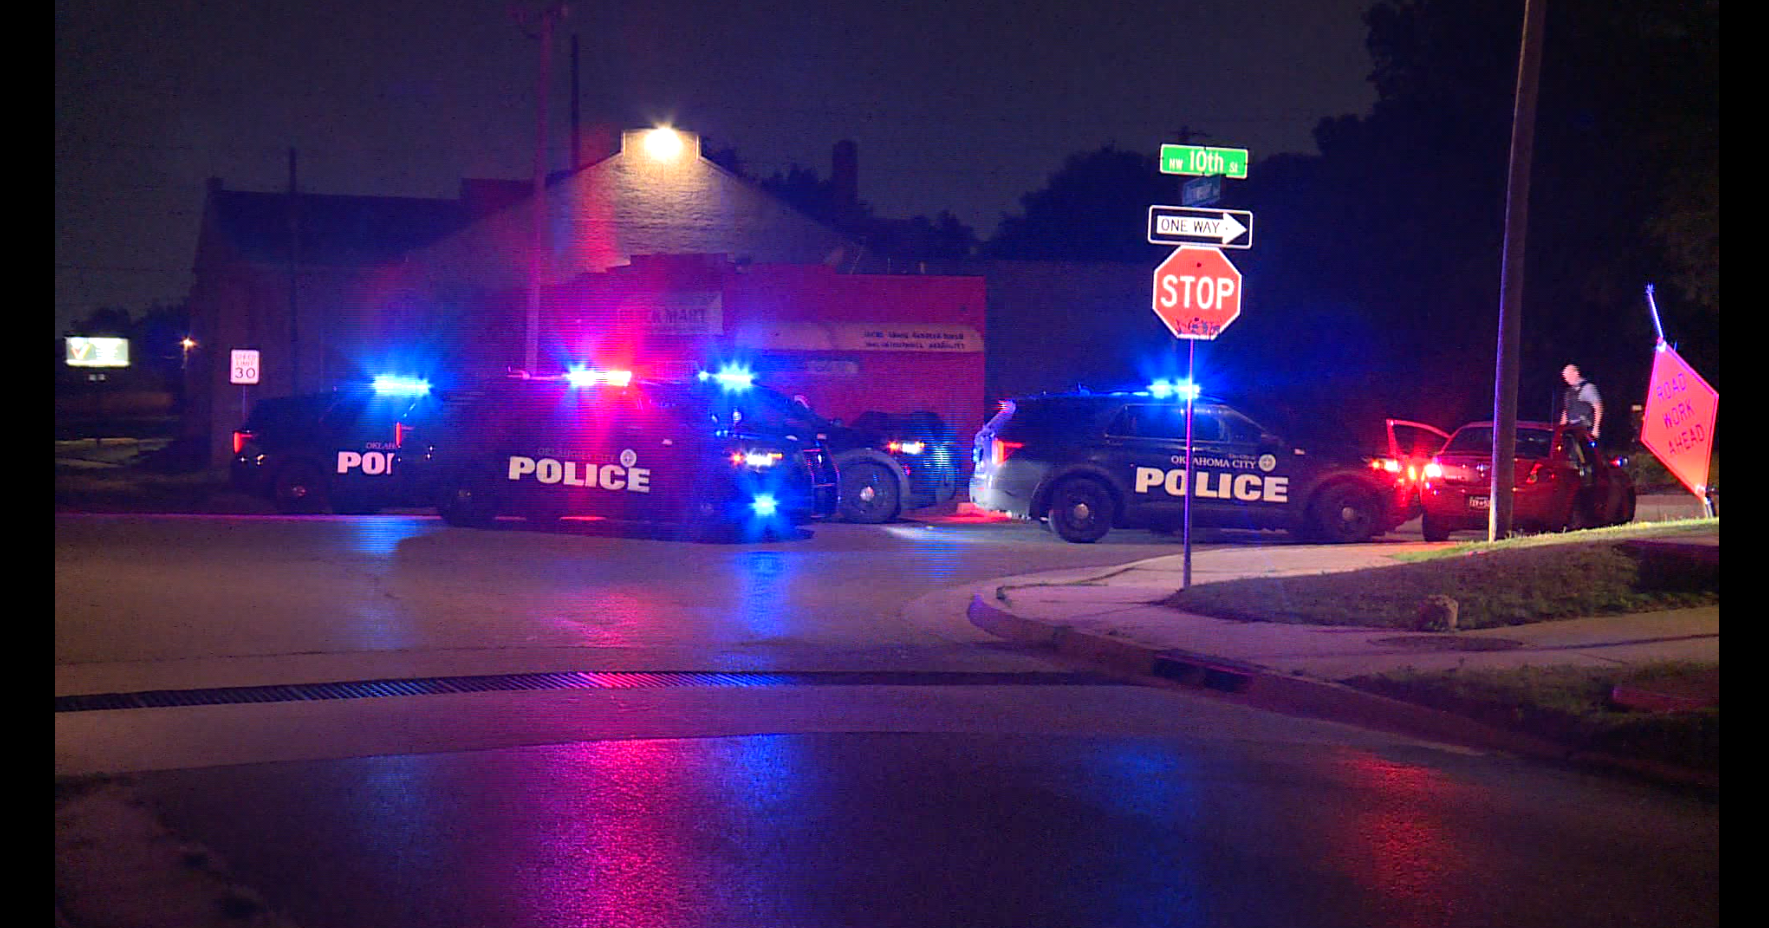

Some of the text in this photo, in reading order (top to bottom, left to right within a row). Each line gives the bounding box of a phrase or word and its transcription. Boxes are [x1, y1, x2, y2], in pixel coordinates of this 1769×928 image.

[1169, 157, 1183, 170] NW
[1190, 150, 1224, 173] 10th
[1161, 218, 1220, 233] ONE WAY
[1160, 274, 1235, 310] STOP
[235, 367, 256, 379] 30
[1657, 373, 1687, 404] ROAD
[1663, 399, 1695, 429] WORK
[1669, 424, 1705, 455] AHEAD
[508, 456, 650, 493] POLICE
[1171, 455, 1230, 468] OKAHOMA
[1232, 460, 1257, 469] CITY
[1135, 467, 1289, 502] POLICE
